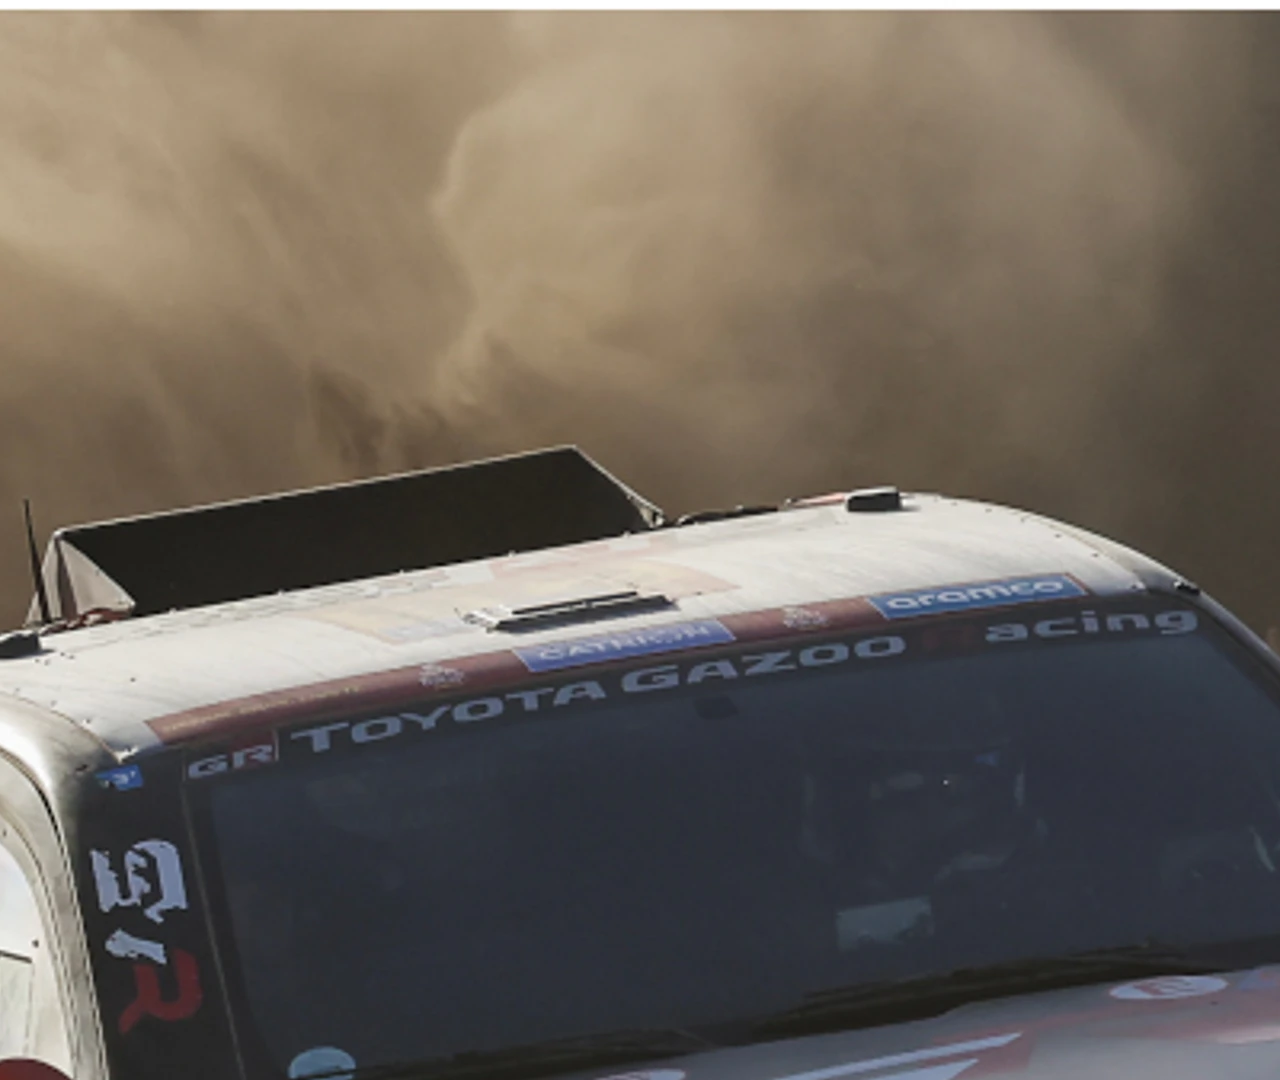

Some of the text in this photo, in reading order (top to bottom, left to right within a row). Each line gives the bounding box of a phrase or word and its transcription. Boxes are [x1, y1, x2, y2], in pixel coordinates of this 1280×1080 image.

[885, 576, 1064, 610] aramco
[187, 743, 273, 780] GR
[291, 678, 606, 753] TOYOTA
[622, 635, 906, 693] GAZOO
[923, 609, 1199, 642] acing
